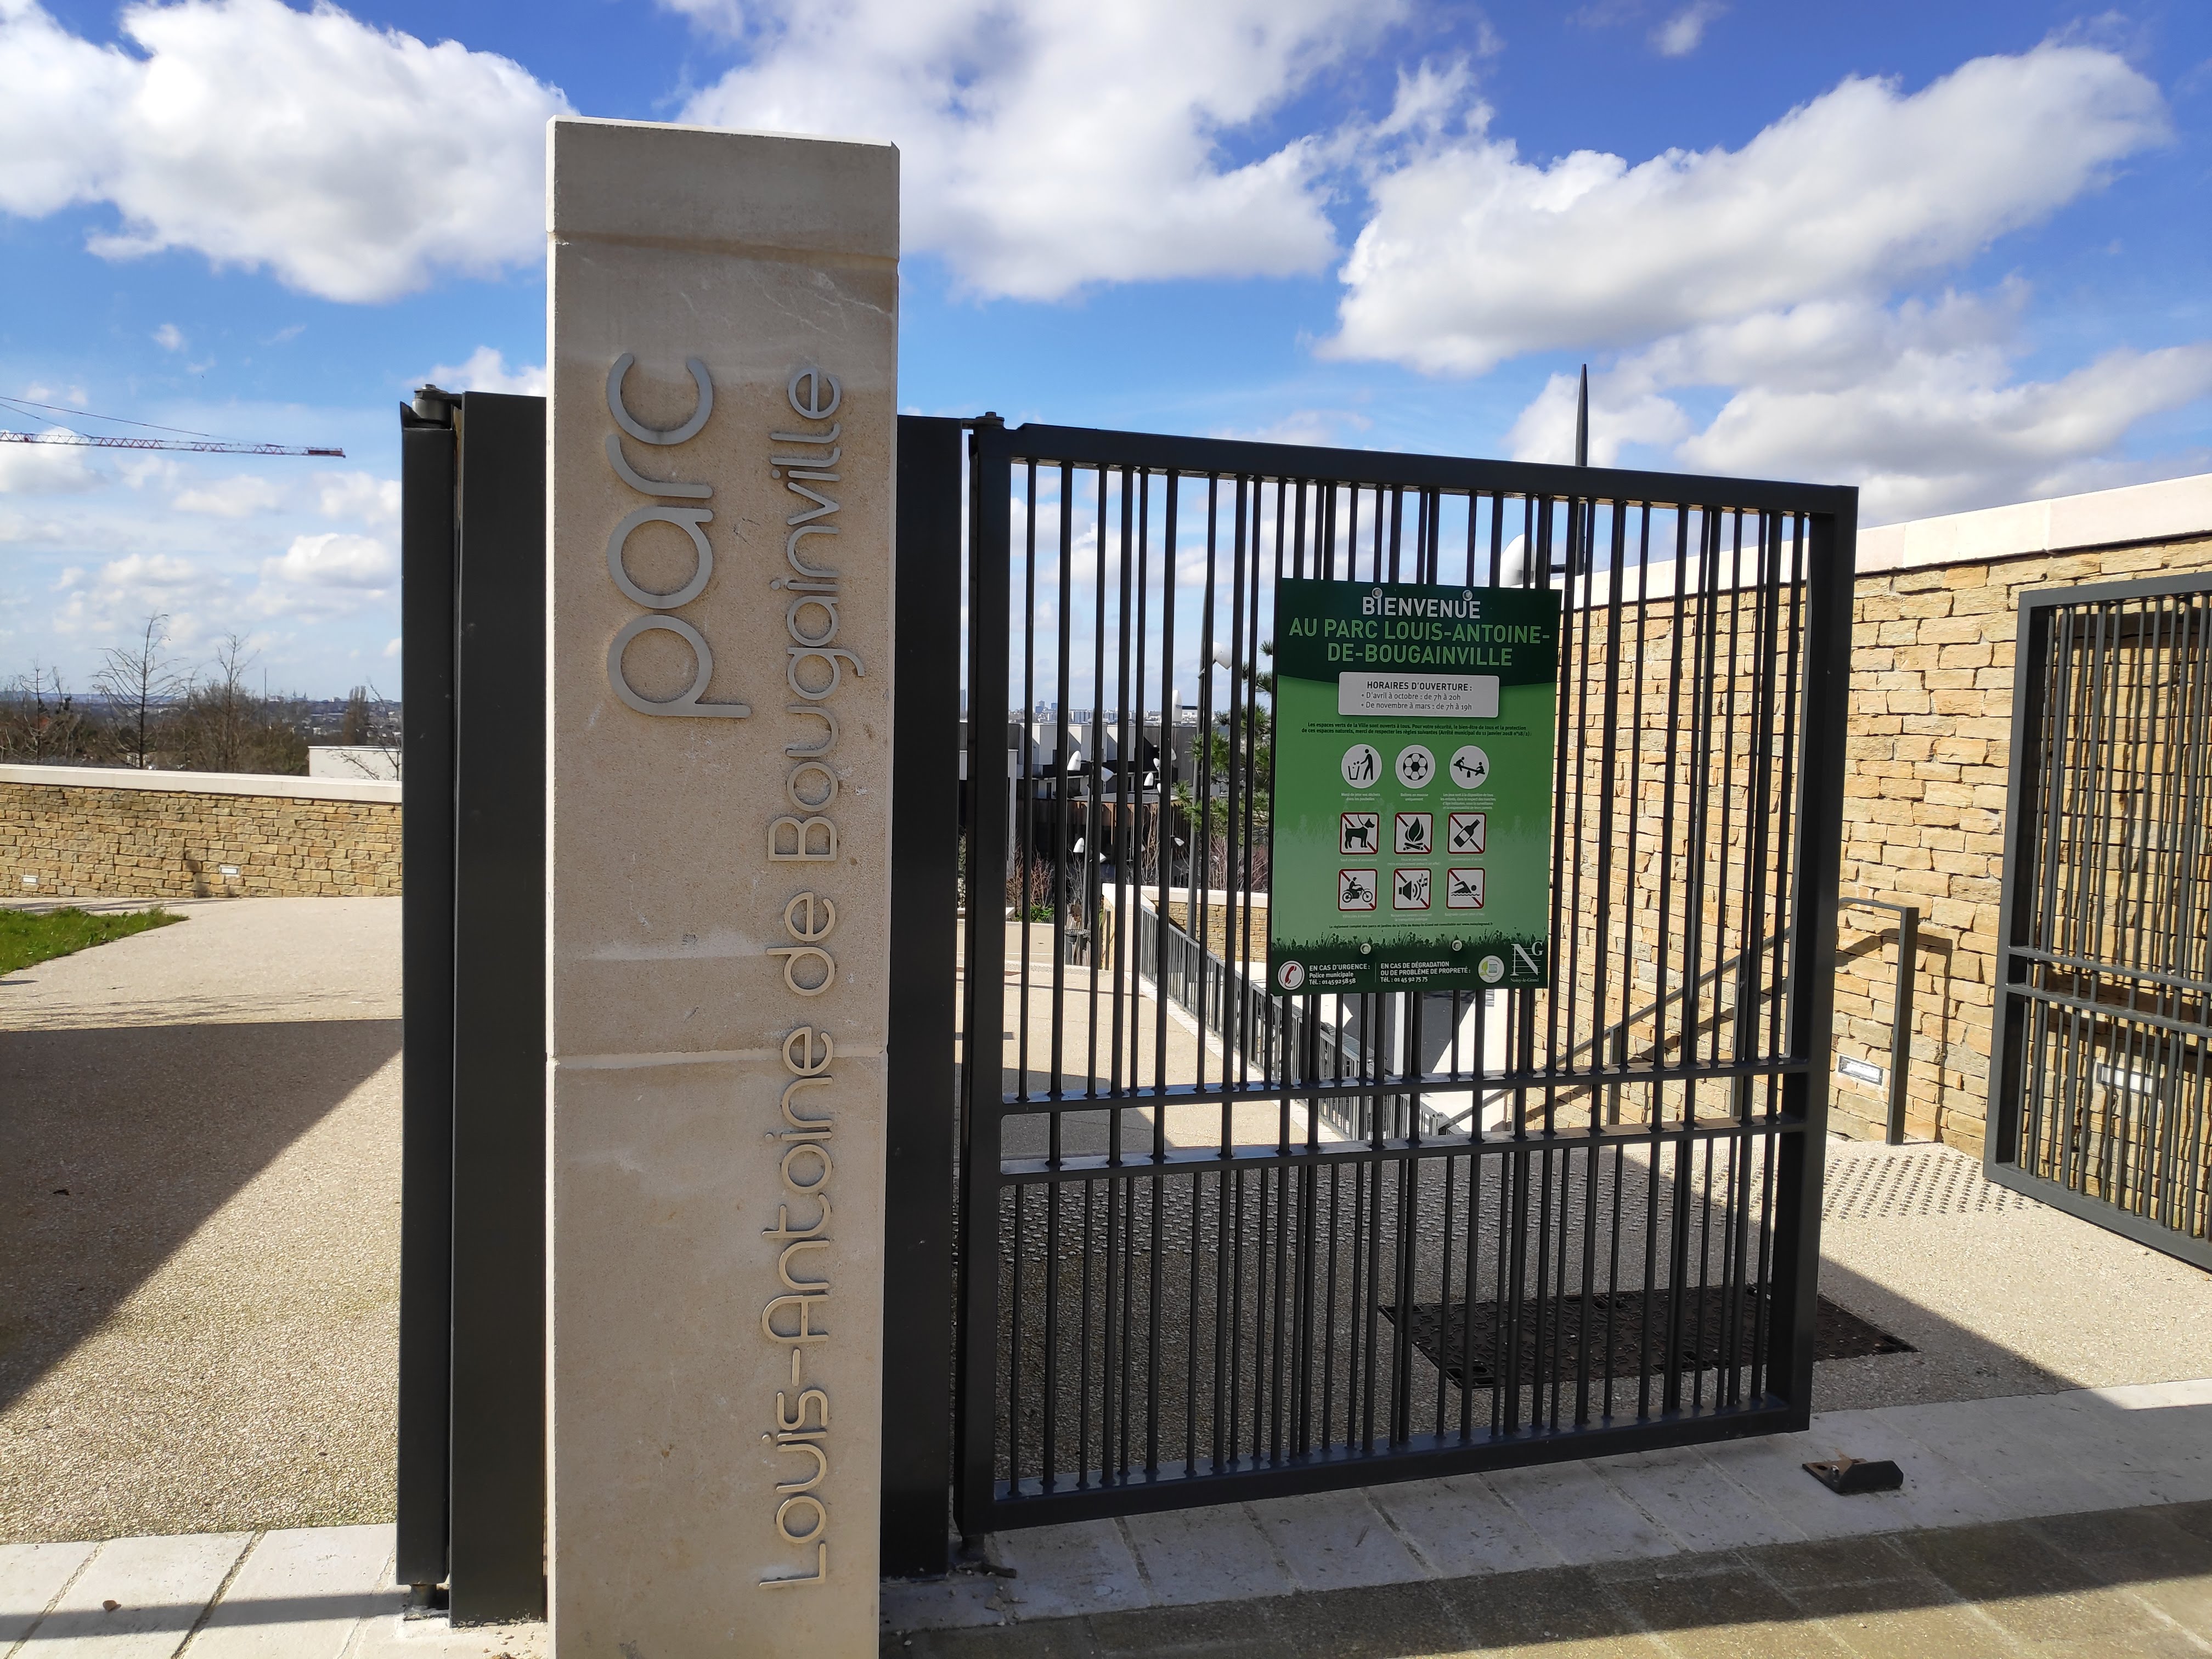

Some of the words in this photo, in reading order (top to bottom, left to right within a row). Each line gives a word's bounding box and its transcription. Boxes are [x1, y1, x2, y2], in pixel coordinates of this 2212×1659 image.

[606, 352, 752, 718] parc
[769, 365, 865, 862] Bougainville
[1362, 596, 1481, 619] BIENVENUE
[1289, 617, 1317, 637] AU
[1324, 618, 1378, 639] PARC
[1384, 620, 1550, 644] LOUIS-ANTOINE-
[1328, 642, 1513, 666] DE-BOUGAINVILLE
[1367, 681, 1409, 690] HORAIRES
[1434, 693, 1442, 701] 7h
[1446, 702, 1454, 711] 7h
[1461, 703, 1472, 712] 19h
[766, 891, 836, 997] de
[759, 1023, 834, 1588] Louis-Antoine
